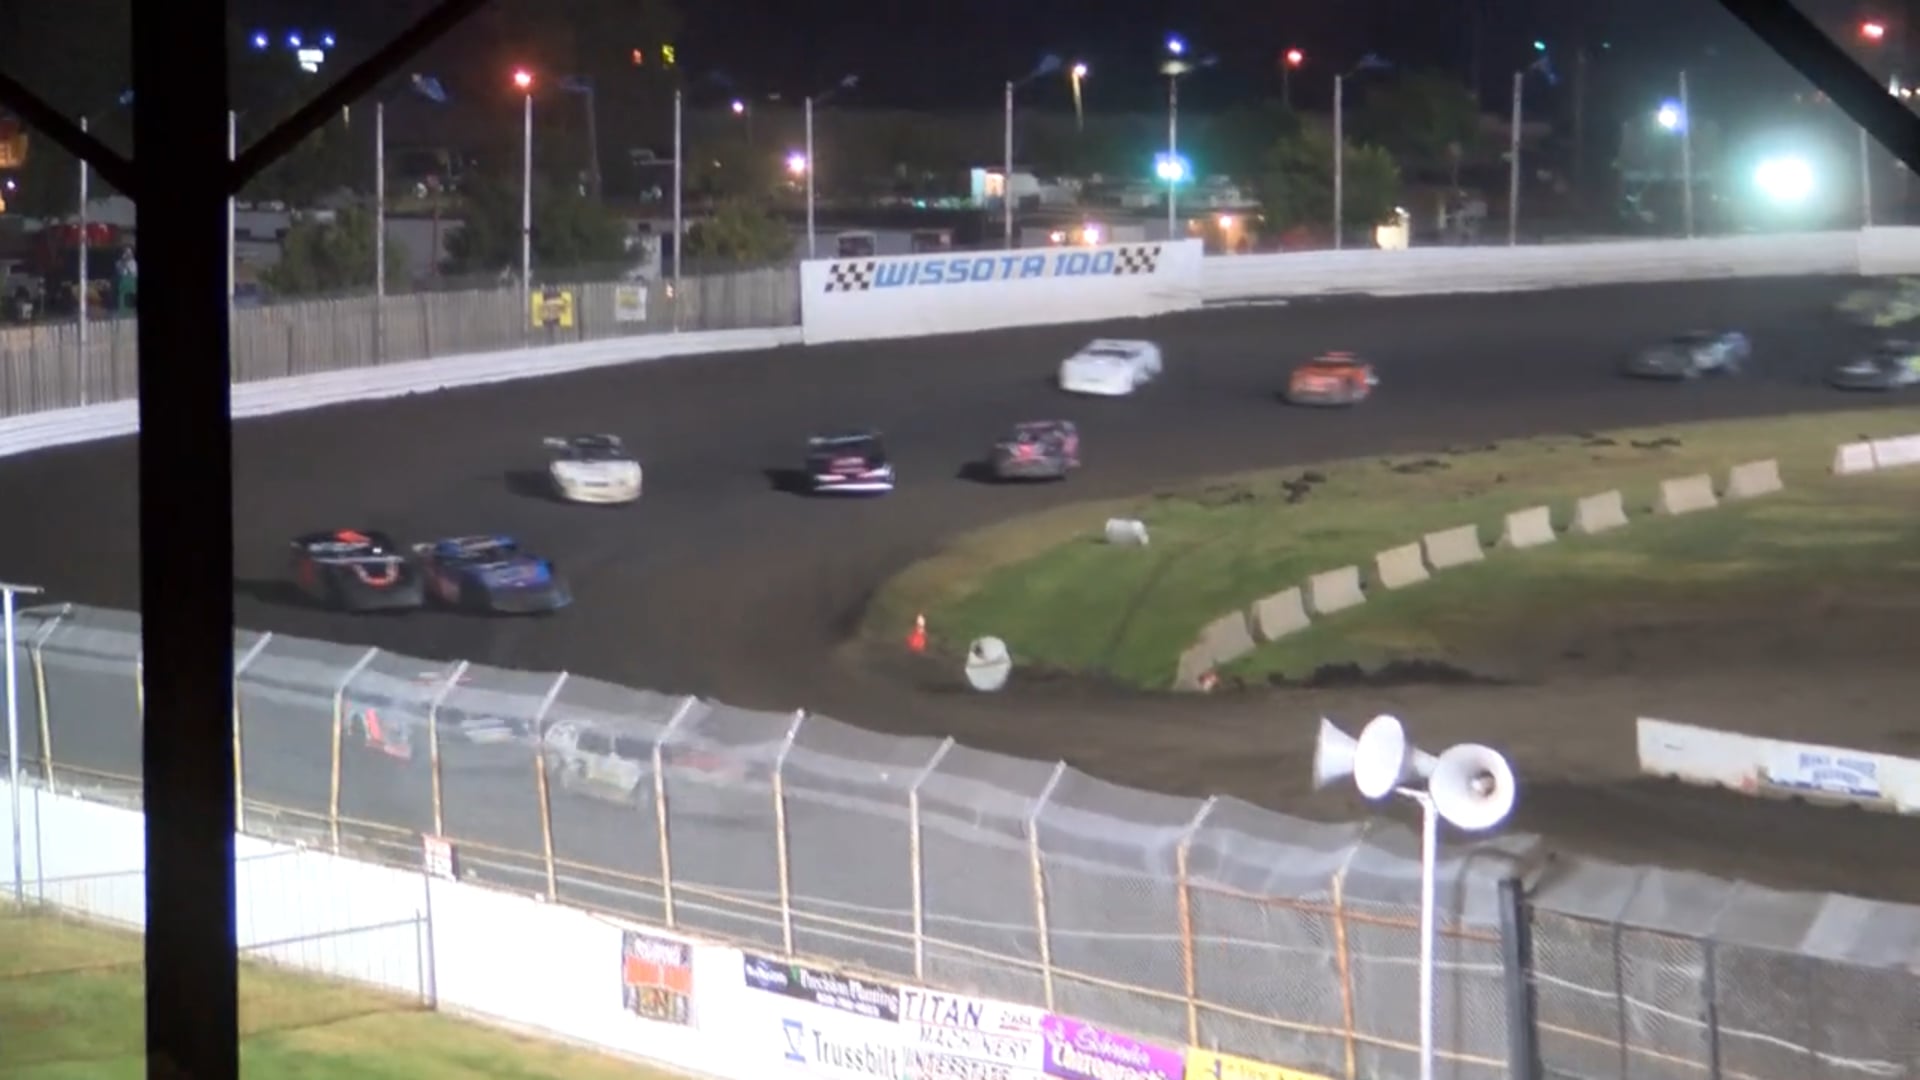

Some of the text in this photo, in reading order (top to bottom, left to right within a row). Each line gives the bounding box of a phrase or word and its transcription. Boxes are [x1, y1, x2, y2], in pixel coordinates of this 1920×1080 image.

[874, 250, 1115, 288] WISSOTA 100
[904, 991, 984, 1028] TITAN
[811, 1028, 899, 1080] Trussbilt
